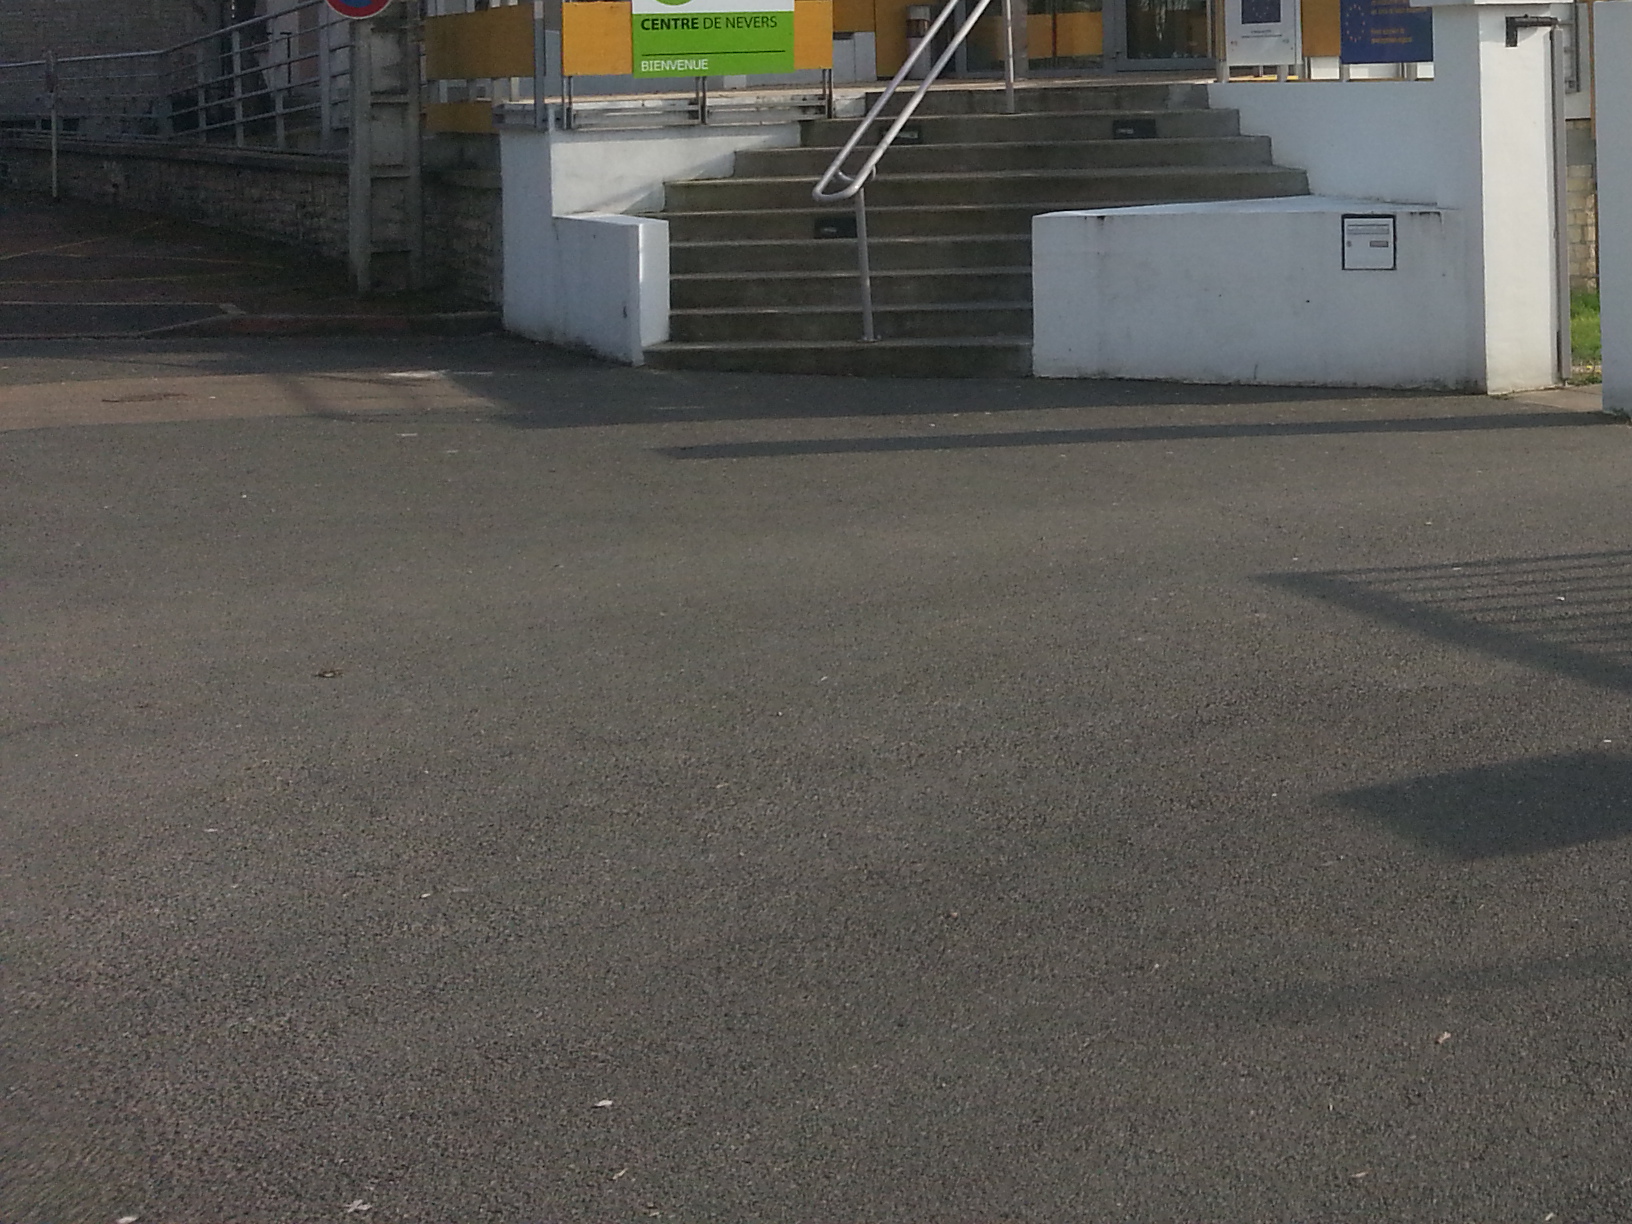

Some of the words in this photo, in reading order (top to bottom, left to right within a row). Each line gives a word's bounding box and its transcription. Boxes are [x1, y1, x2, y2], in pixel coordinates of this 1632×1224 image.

[640, 17, 700, 31] CENTRE
[703, 17, 721, 30] DE
[726, 16, 778, 29] NEVERS
[641, 59, 709, 72] BIENVENUE
